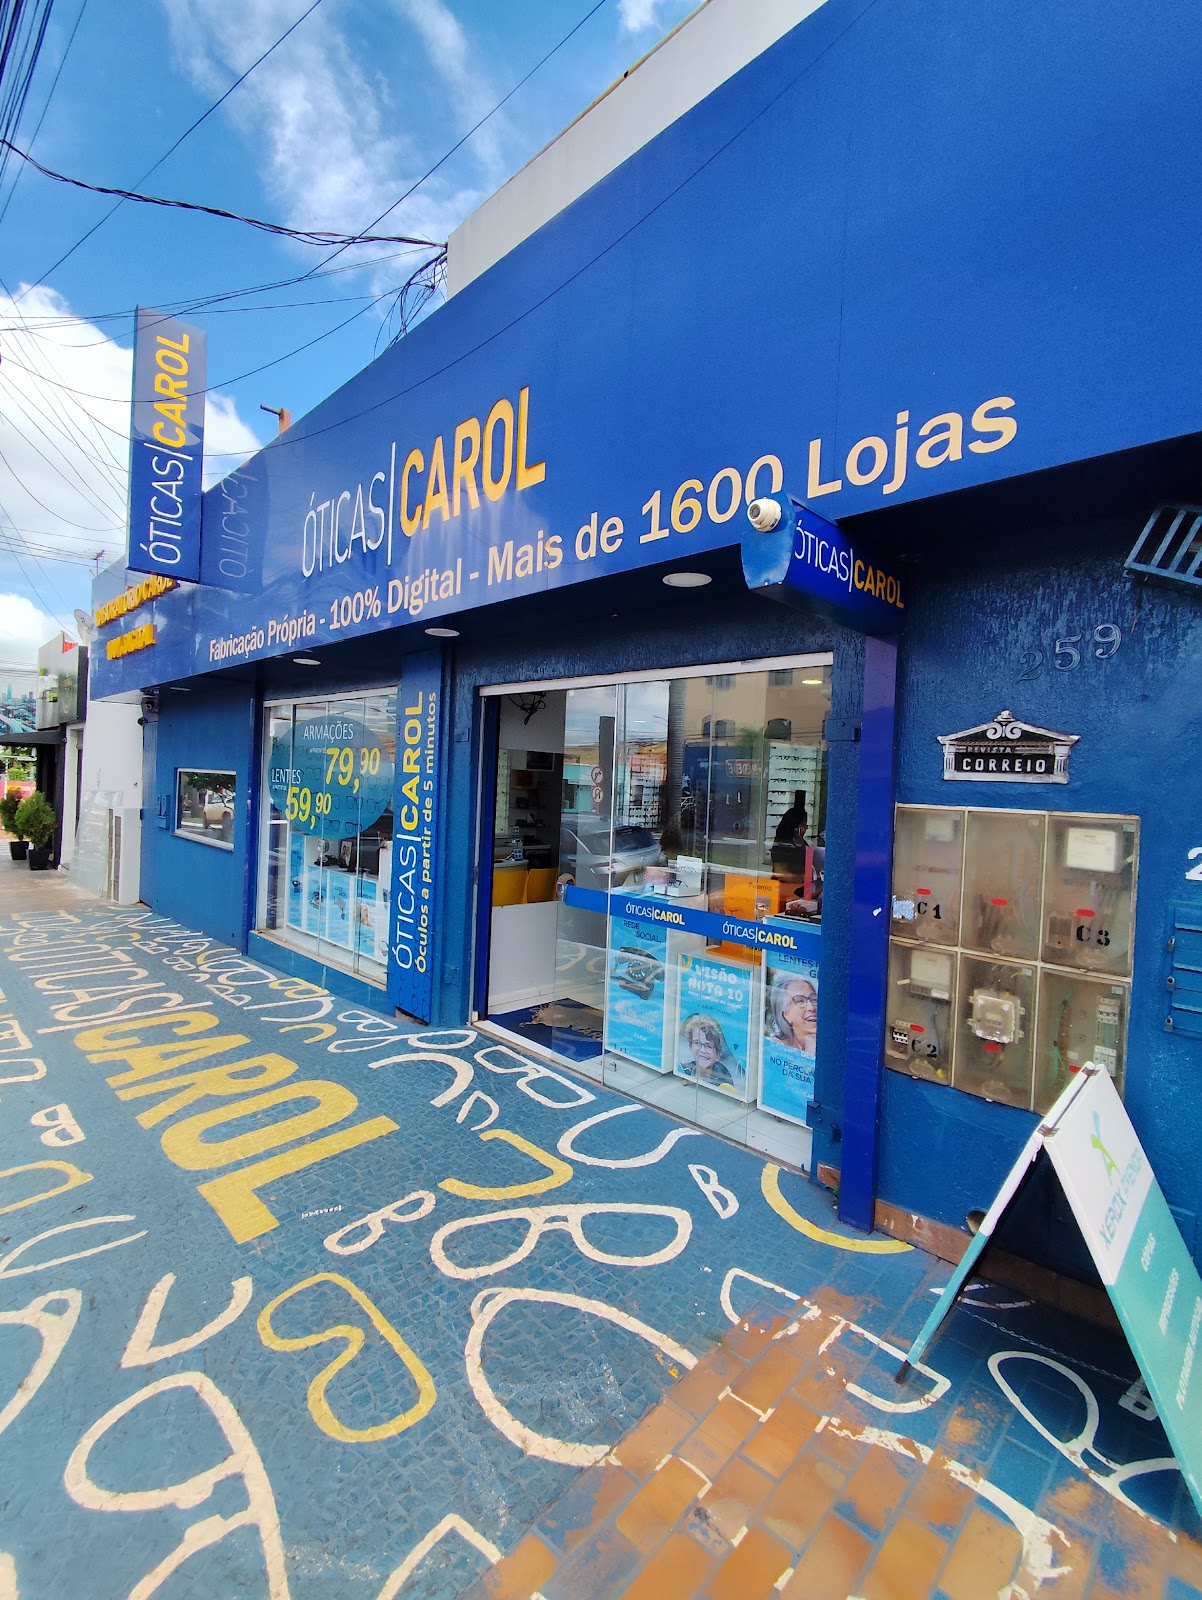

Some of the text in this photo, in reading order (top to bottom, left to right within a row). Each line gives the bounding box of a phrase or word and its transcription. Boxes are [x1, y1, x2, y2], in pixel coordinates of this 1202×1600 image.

[140, 332, 190, 566] ÓTICAS CAROL
[300, 386, 546, 578] ÓTICAS CAROL
[209, 624, 264, 662] Fabricação
[267, 612, 316, 653] Própria
[328, 586, 381, 630] 100%
[387, 557, 462, 616] Digital
[487, 530, 564, 587] Mais
[575, 512, 624, 561] de
[640, 454, 784, 544] 1600
[807, 396, 1018, 495] Lojas
[854, 559, 905, 609] CAROL
[1018, 623, 1122, 683] 259
[303, 721, 354, 743] ARMAÇÕES
[271, 769, 302, 785] LENTES
[326, 747, 380, 794] 79,90
[962, 758, 1046, 773] CORREIO
[285, 787, 332, 830] 59,90
[392, 691, 424, 970] ÓTICAS CAROL
[415, 692, 436, 974] Óculos a partir de 5 minutos
[623, 920, 640, 930] REDE
[625, 901, 686, 926] ÓTICAS CAROL
[722, 921, 797, 949] ÓTICAS CAROL
[778, 954, 814, 968] LENTES
[770, 1056, 782, 1066] NO
[782, 1068, 812, 1085] DA SUA
[73, 1011, 400, 1244] CAROL
[1099, 1186, 1127, 1252] XEROX
